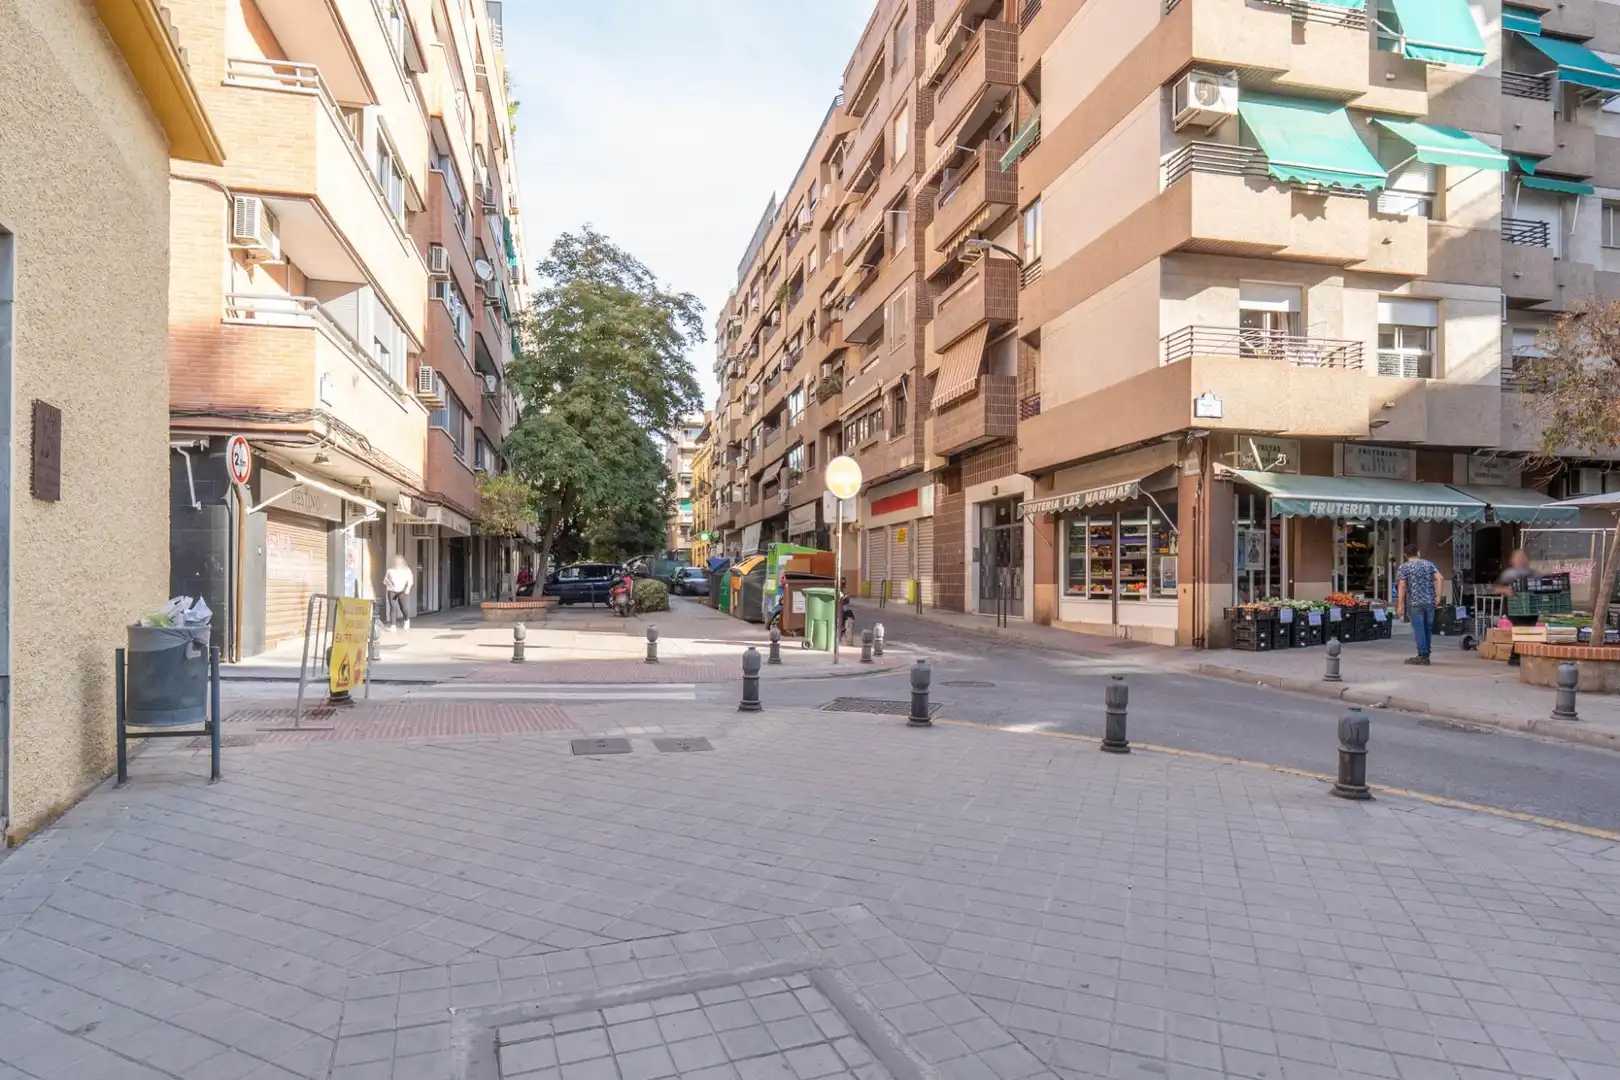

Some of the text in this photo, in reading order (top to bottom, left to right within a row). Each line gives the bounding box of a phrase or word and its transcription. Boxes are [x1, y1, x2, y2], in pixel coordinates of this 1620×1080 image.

[291, 488, 322, 513] DESTINO
[1024, 484, 1131, 514] FRUTERIA LAS MARINAS
[1309, 501, 1459, 518] FRUTERIA LAS MARINAS
